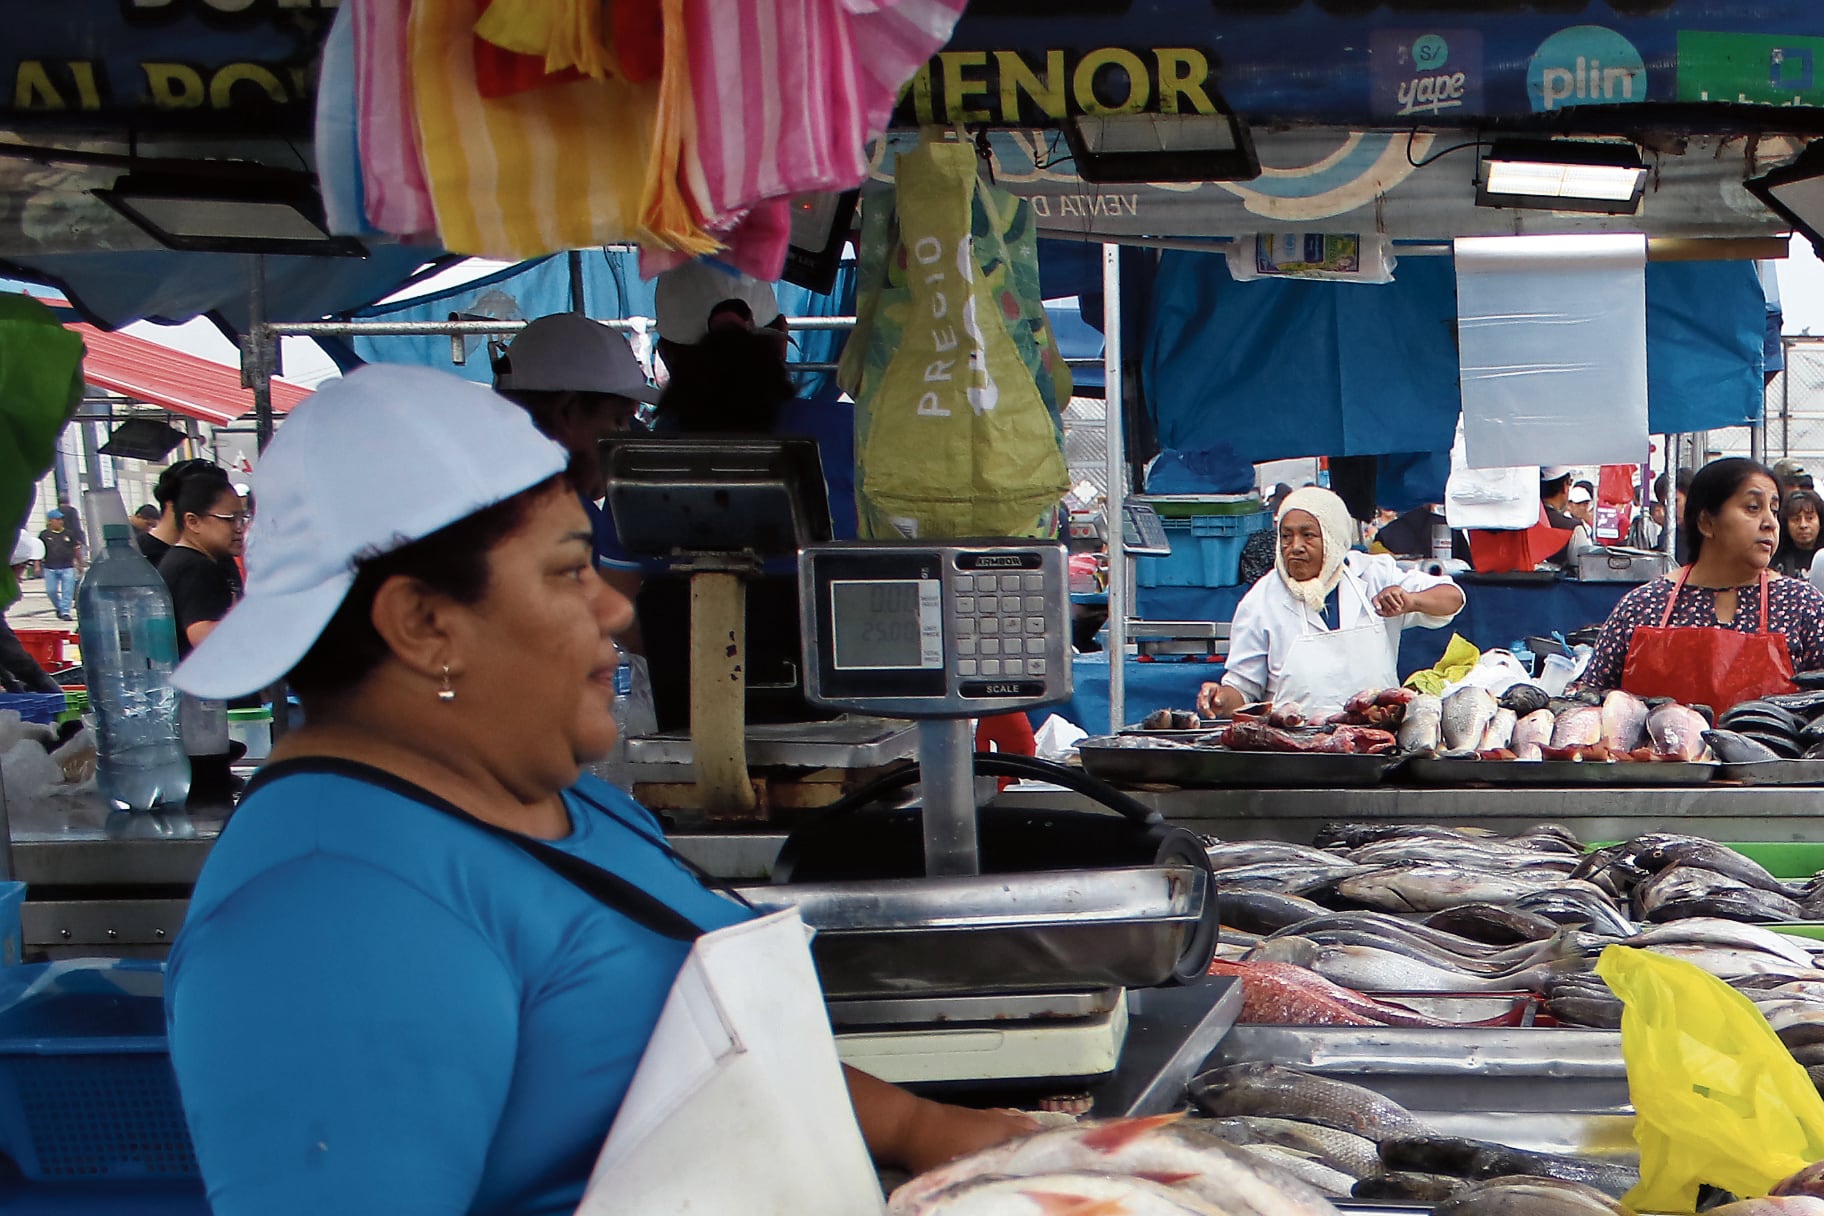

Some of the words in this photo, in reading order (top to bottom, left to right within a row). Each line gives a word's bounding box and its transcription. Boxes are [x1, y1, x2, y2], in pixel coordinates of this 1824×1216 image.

[1397, 71, 1465, 116] yape
[1543, 56, 1633, 111] plin
[986, 684, 1020, 693] SCALE
